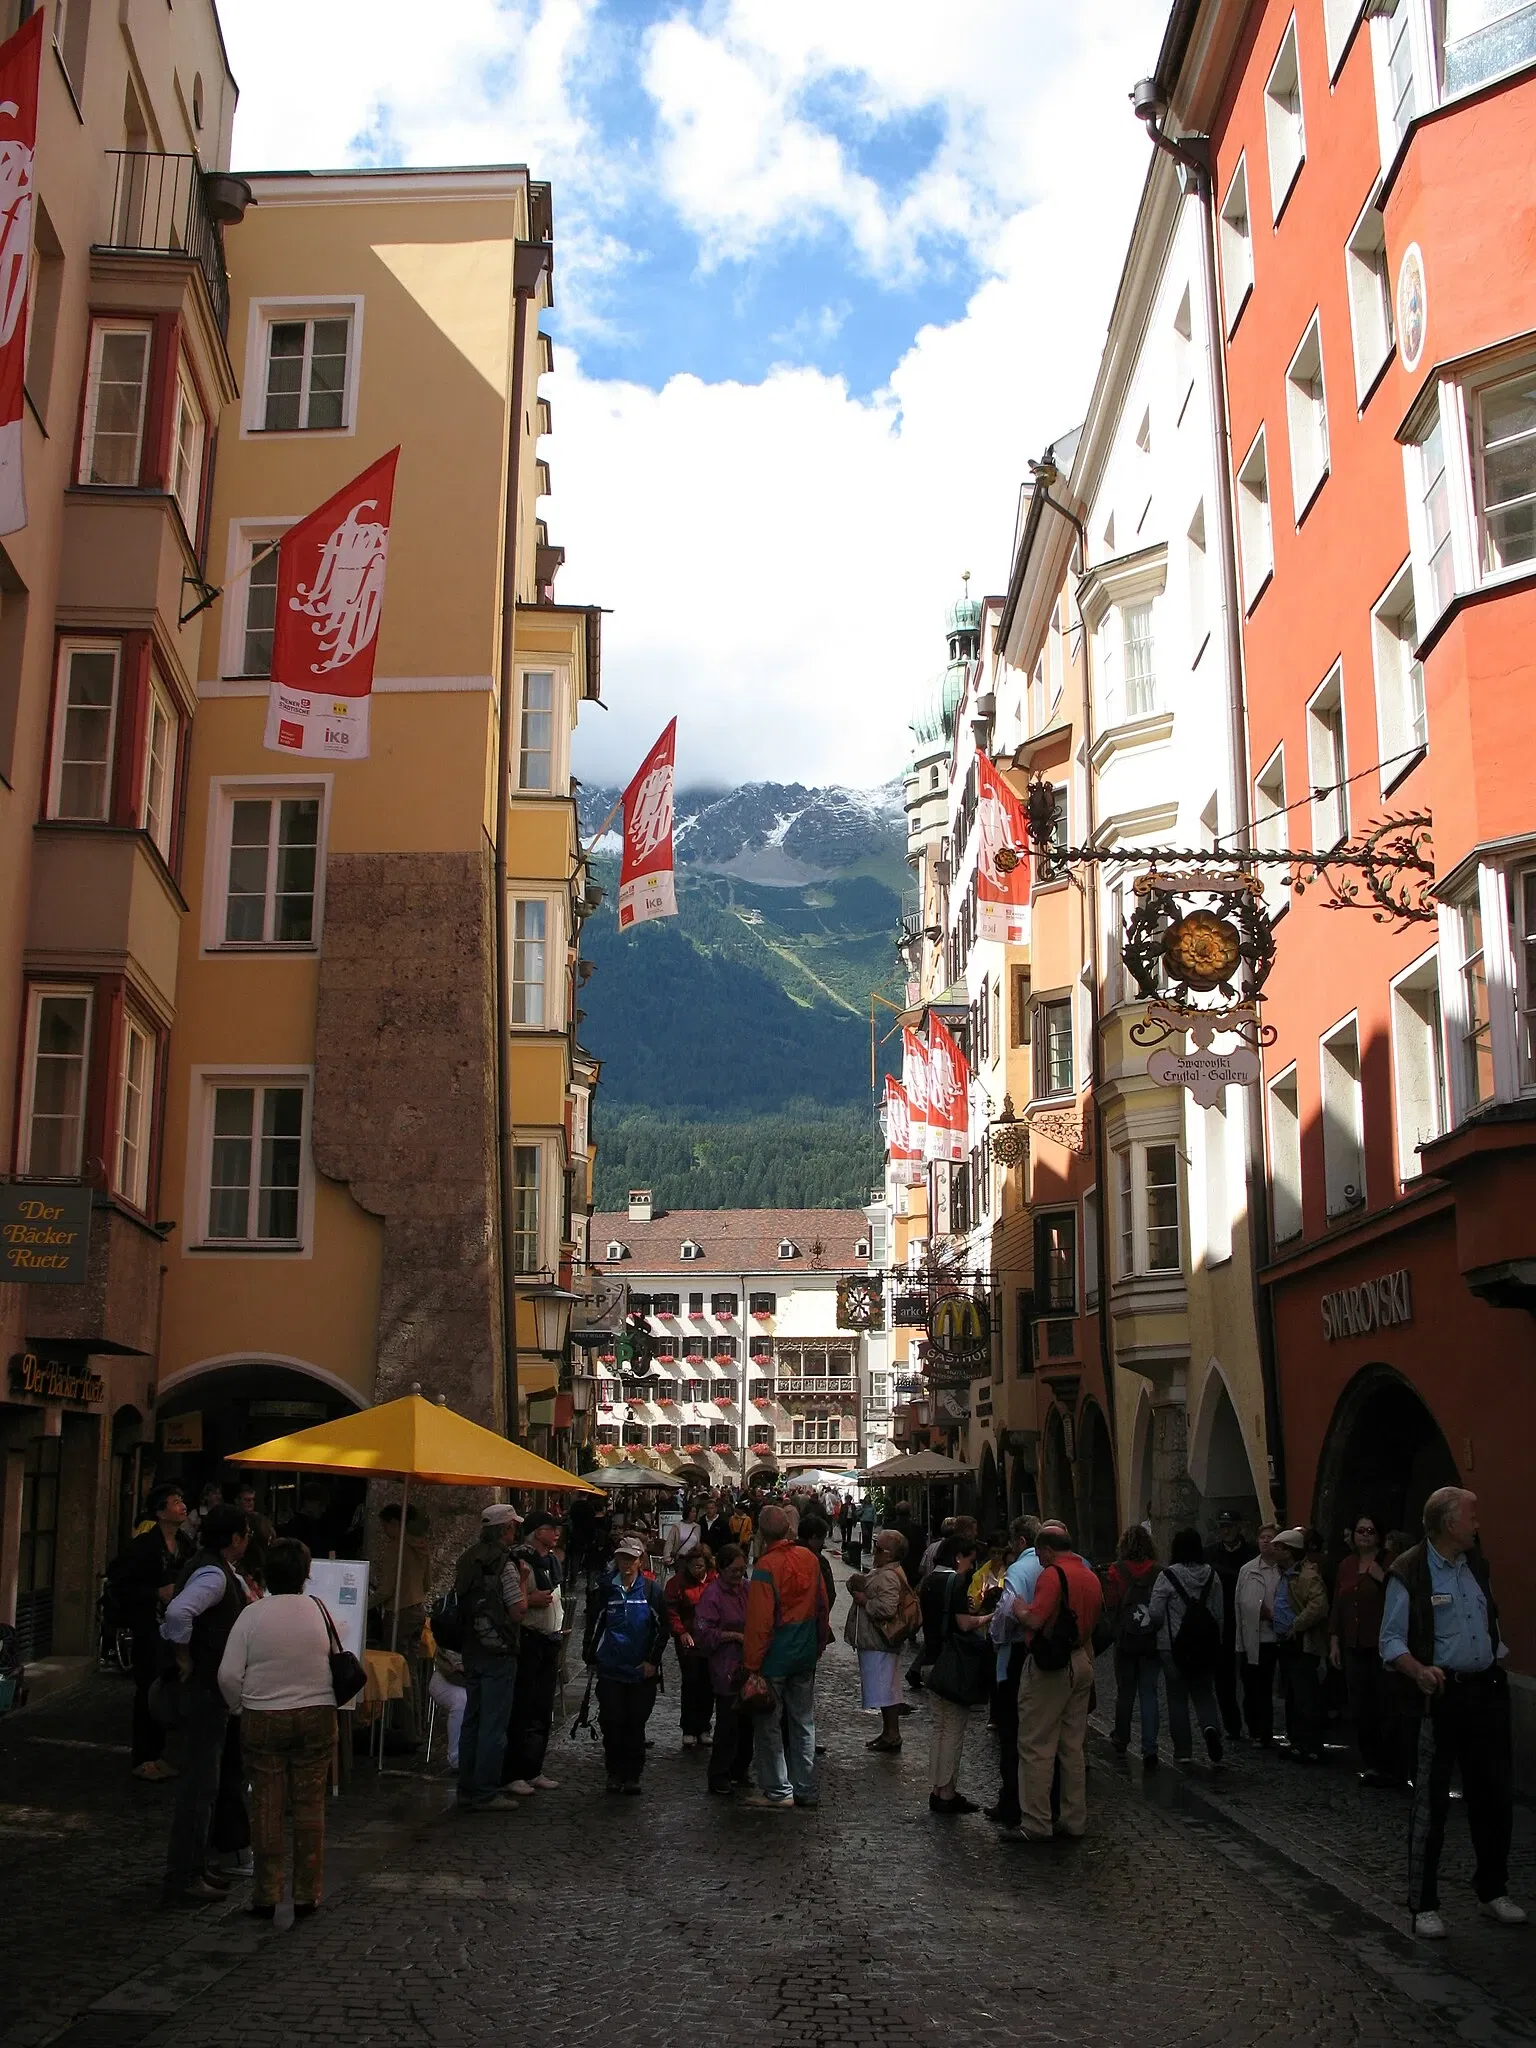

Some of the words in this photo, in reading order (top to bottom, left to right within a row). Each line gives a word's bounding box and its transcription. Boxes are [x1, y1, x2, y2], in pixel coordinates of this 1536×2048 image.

[18, 1200, 64, 1220] Der
[3, 1224, 78, 1245] Bäcker
[7, 1249, 70, 1269] Ruetz
[900, 1306, 923, 1317] arko
[1320, 1268, 1412, 1341] SWAROVSKI
[22, 1353, 45, 1393] Der
[47, 1360, 78, 1398] Bäcker
[80, 1367, 105, 1402] Ruetz
